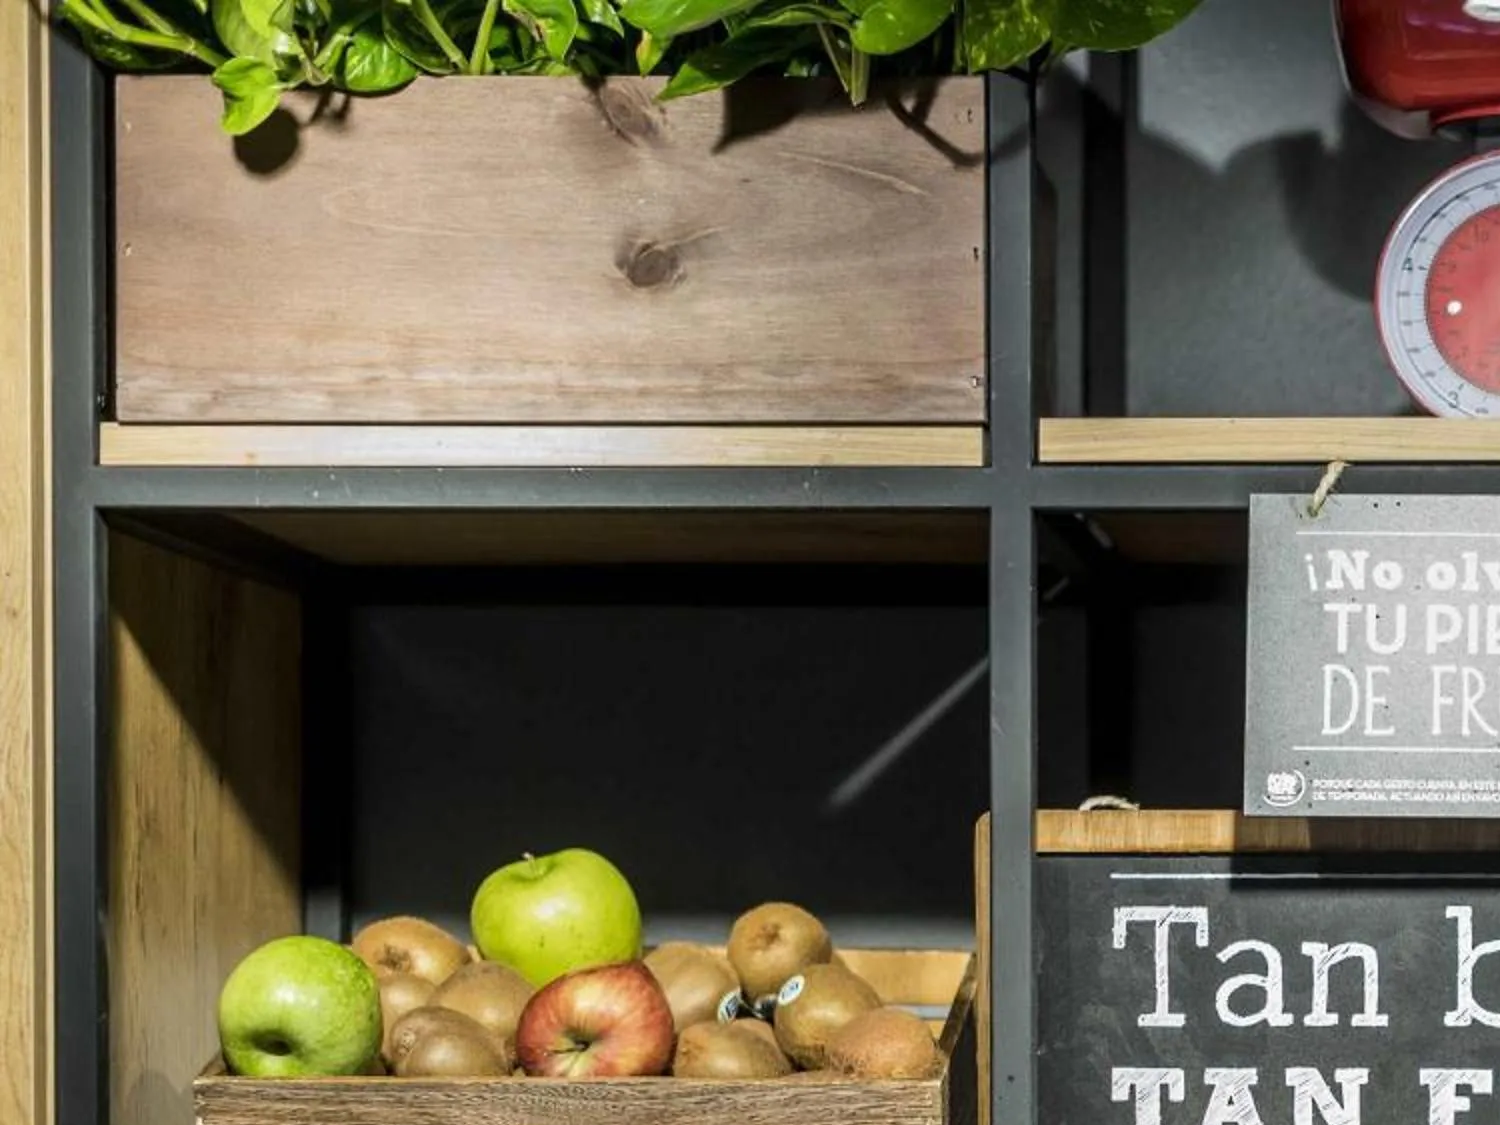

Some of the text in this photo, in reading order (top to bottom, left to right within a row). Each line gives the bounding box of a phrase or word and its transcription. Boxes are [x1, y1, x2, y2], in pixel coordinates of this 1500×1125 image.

[1304, 549, 1403, 592] ¡No
[1324, 603, 1407, 655] TU
[1321, 664, 1395, 736] DE
[1112, 905, 1389, 1028] Tan
